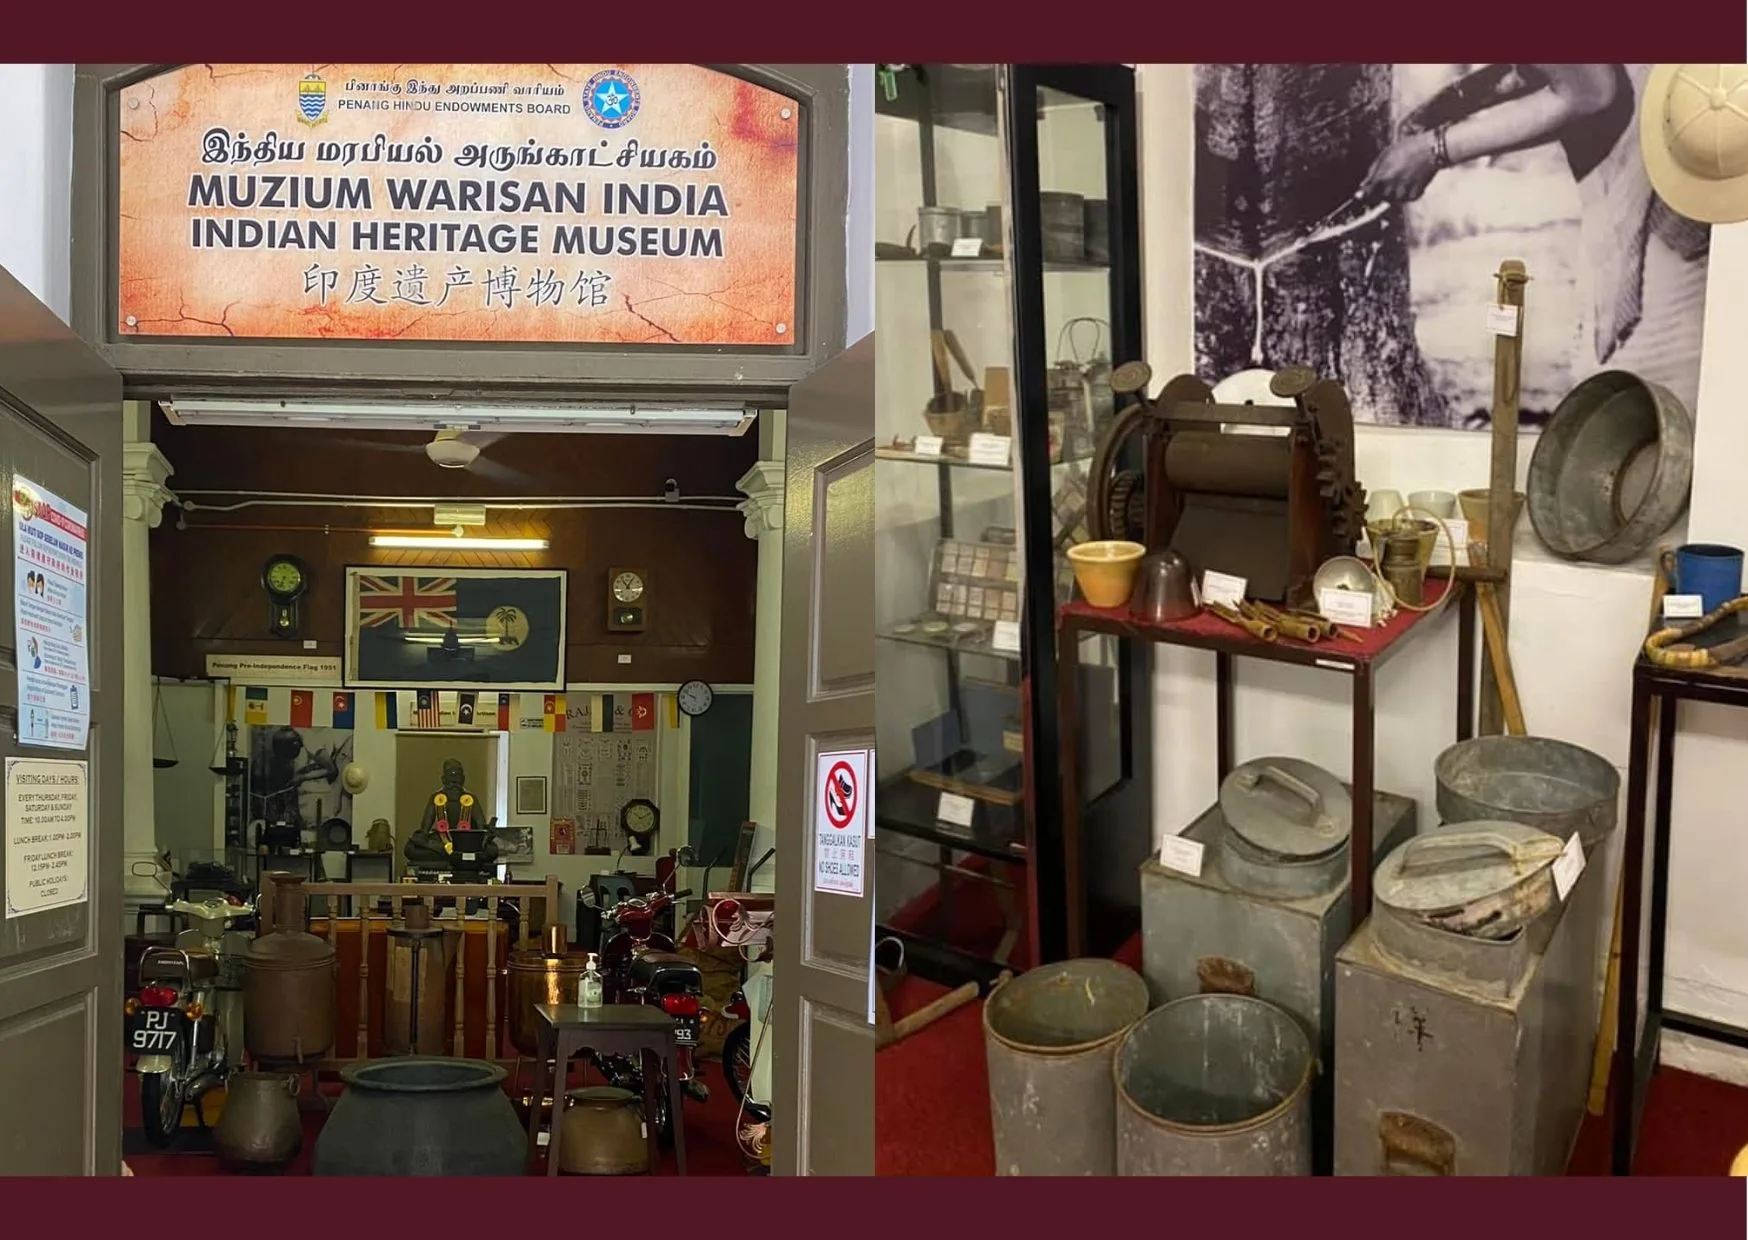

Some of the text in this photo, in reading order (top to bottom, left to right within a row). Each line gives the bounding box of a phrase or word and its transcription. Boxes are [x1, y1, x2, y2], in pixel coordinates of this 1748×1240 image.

[406, 78, 441, 96] இந்து
[513, 83, 565, 97] வாரியம்
[338, 99, 571, 115] PENANG HINDU ENDOWMENTS BOARD
[202, 128, 716, 173] இந்திய மரபியல் அருங்காட்சியகம்
[188, 175, 729, 216] MUZIUM WARISAN INDIA
[192, 219, 724, 257] INDIAN HERITAGE MUSEUM
[303, 263, 611, 308] 印度遗产博物馆
[16, 774, 41, 784] VISITING
[42, 775, 56, 785] DAYS
[146, 1010, 169, 1030] PJ
[132, 1030, 177, 1050] 9717
[674, 1028, 692, 1041] 93
